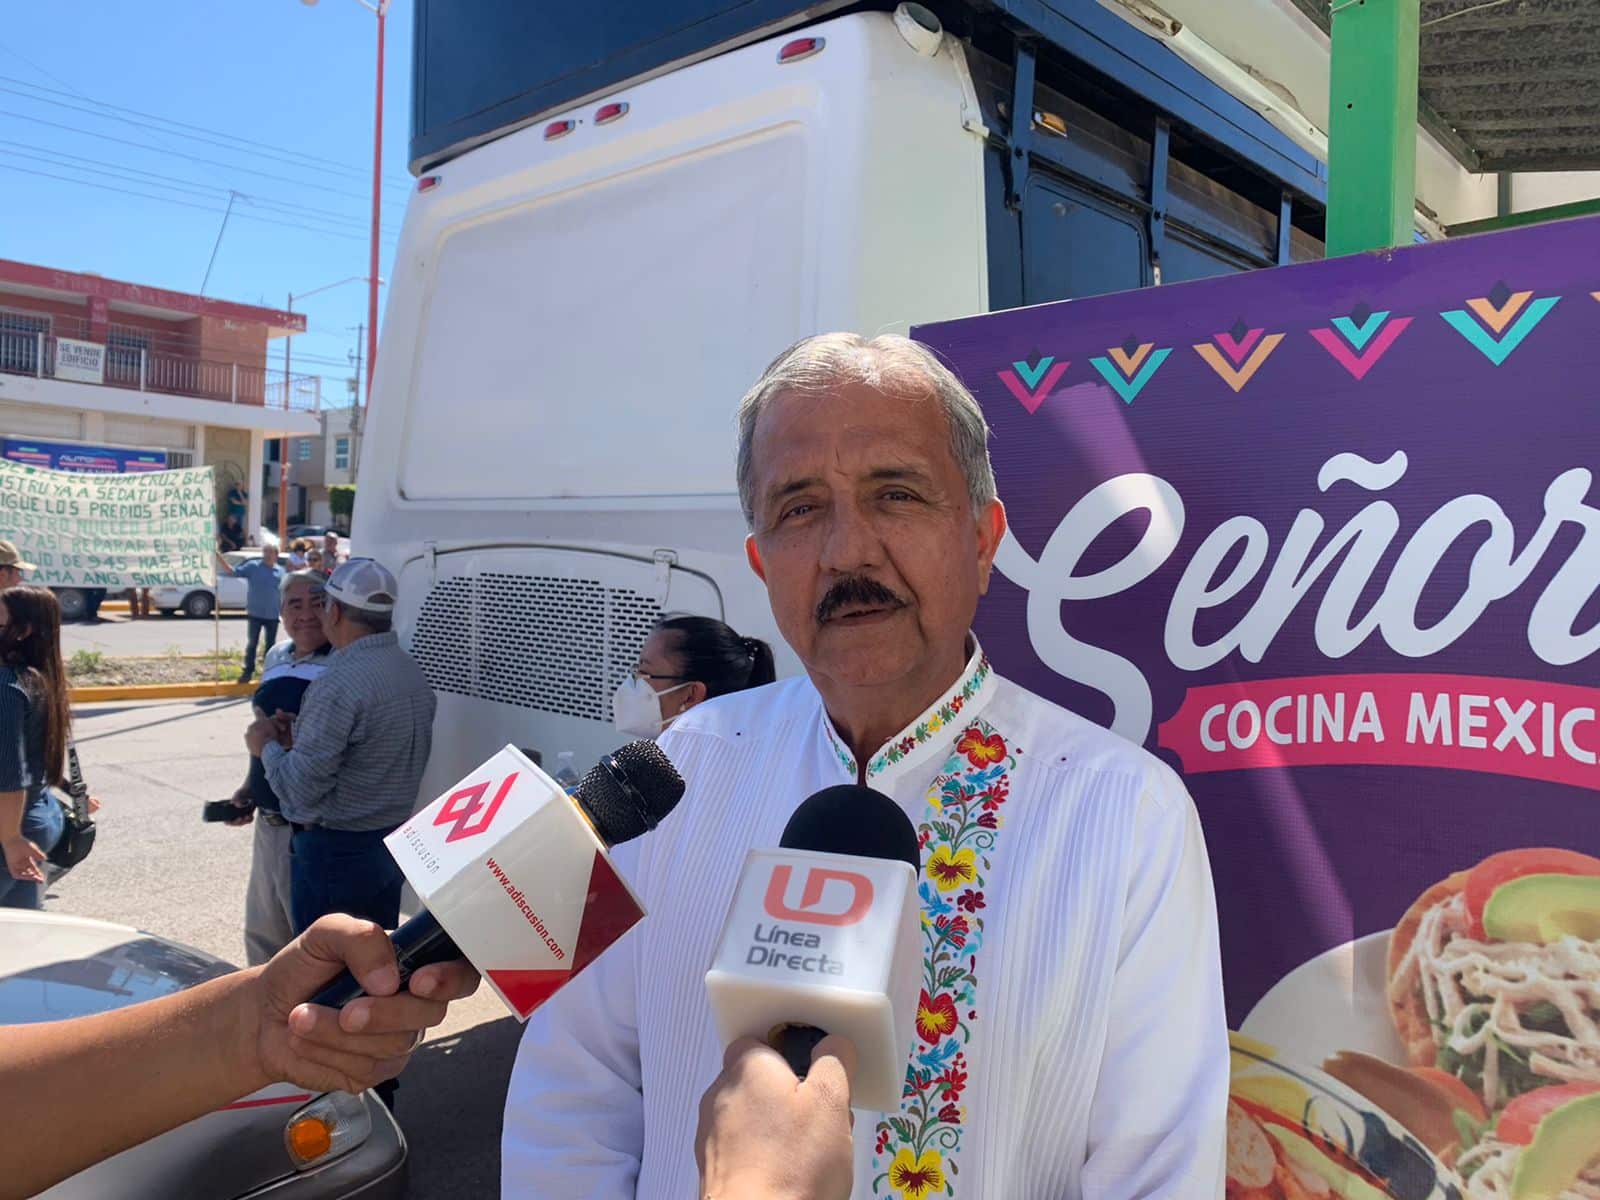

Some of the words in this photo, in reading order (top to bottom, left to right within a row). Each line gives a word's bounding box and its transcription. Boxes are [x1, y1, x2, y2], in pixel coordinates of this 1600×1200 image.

[96, 487, 158, 503] SEDATU
[45, 499, 80, 516] LOS
[89, 501, 152, 519] PREDIOS
[62, 552, 82, 569] DE
[87, 554, 127, 571] 945
[182, 554, 209, 570] DEL
[131, 571, 206, 586] SINALOA
[1200, 692, 1384, 753] COCINA
[486, 857, 565, 960] www.adiscusion.com
[754, 923, 821, 949] Línea
[746, 946, 844, 976] Directa
